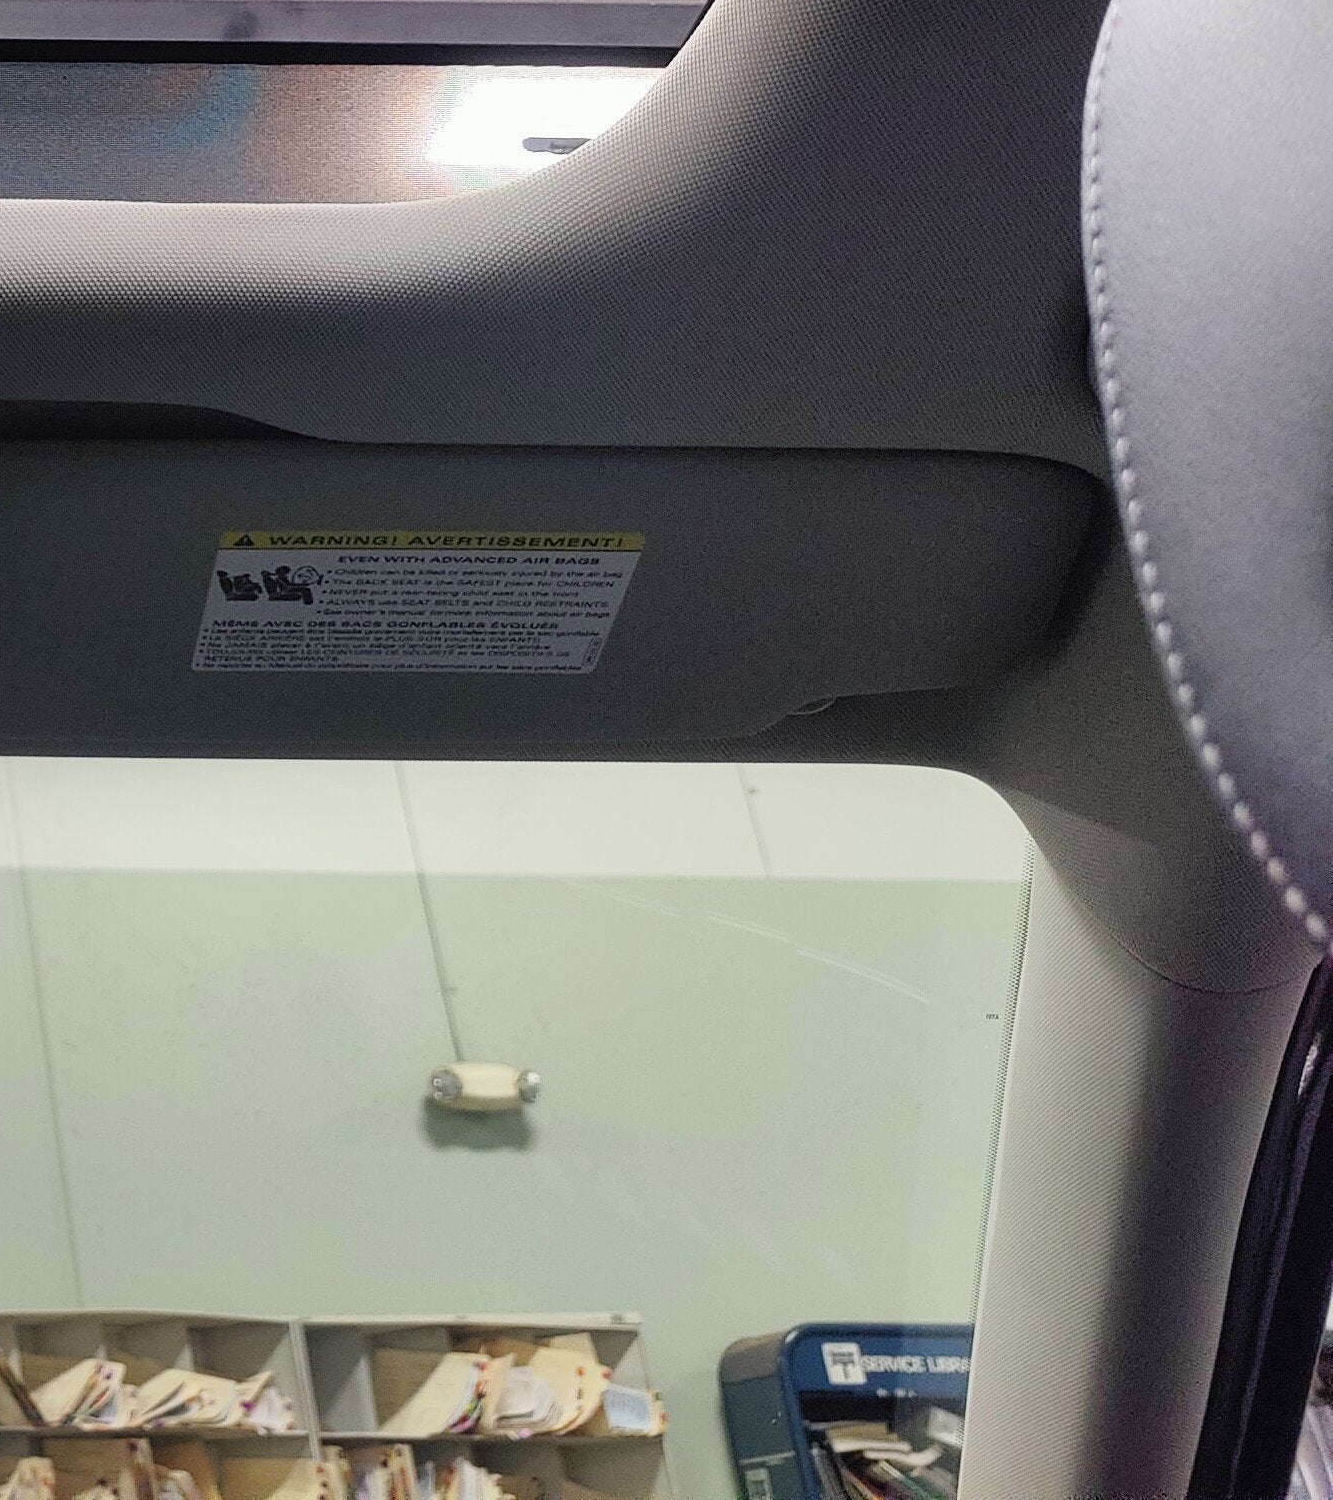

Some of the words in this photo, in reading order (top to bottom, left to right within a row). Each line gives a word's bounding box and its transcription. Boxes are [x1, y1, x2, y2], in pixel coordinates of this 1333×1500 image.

[270, 535, 397, 546] WARNING!
[408, 536, 622, 547] AVERTISSEMENT!
[384, 556, 425, 564] WITH
[429, 556, 517, 564] ADVANCED
[522, 557, 549, 565] AIR
[555, 557, 600, 565] BAGS
[860, 1355, 927, 1373] SERVICE
